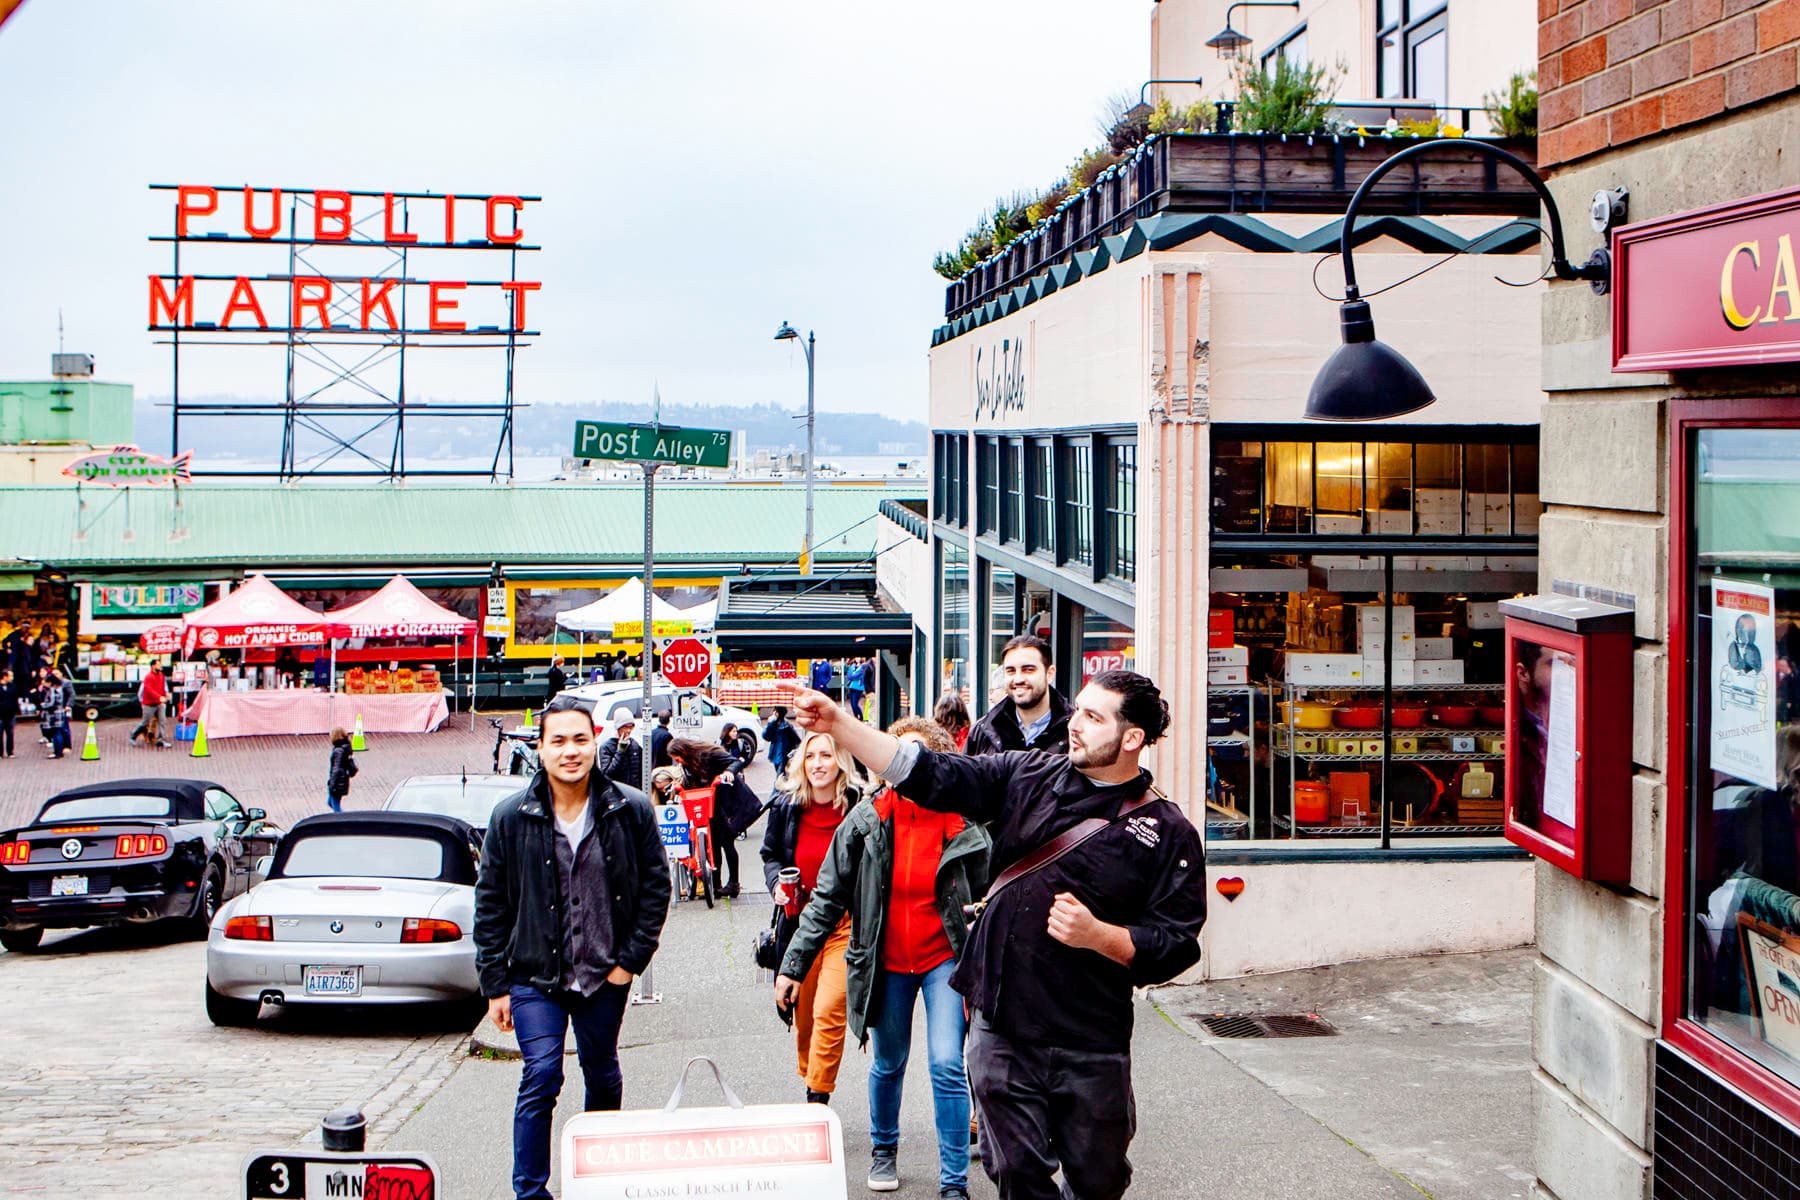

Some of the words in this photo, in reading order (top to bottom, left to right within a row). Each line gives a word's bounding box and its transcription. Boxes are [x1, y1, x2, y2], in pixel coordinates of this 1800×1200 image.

[178, 185, 524, 244] PUBLIC
[149, 275, 542, 331] MARKET
[581, 424, 640, 456] Post
[653, 438, 705, 464] Alley
[712, 432, 727, 446] 75
[95, 585, 200, 608] TULIPS
[224, 634, 248, 645] HOT
[250, 633, 286, 644] APPLE
[289, 631, 323, 642] CIDER
[244, 625, 296, 634] ORGANIC
[349, 624, 394, 637] TINY'S
[396, 623, 464, 636] ORGANIC
[665, 653, 708, 673] STOP
[676, 825, 686, 833] to
[661, 835, 683, 844] Park
[309, 975, 355, 990] ATR7366
[585, 1139, 650, 1166] CAFÉ
[663, 1131, 820, 1161] CAMPAGNE
[270, 1162, 290, 1194] 3
[326, 1174, 362, 1197] MIN
[625, 1185, 680, 1199] CLASSIC
[686, 1181, 740, 1195] FRENCH
